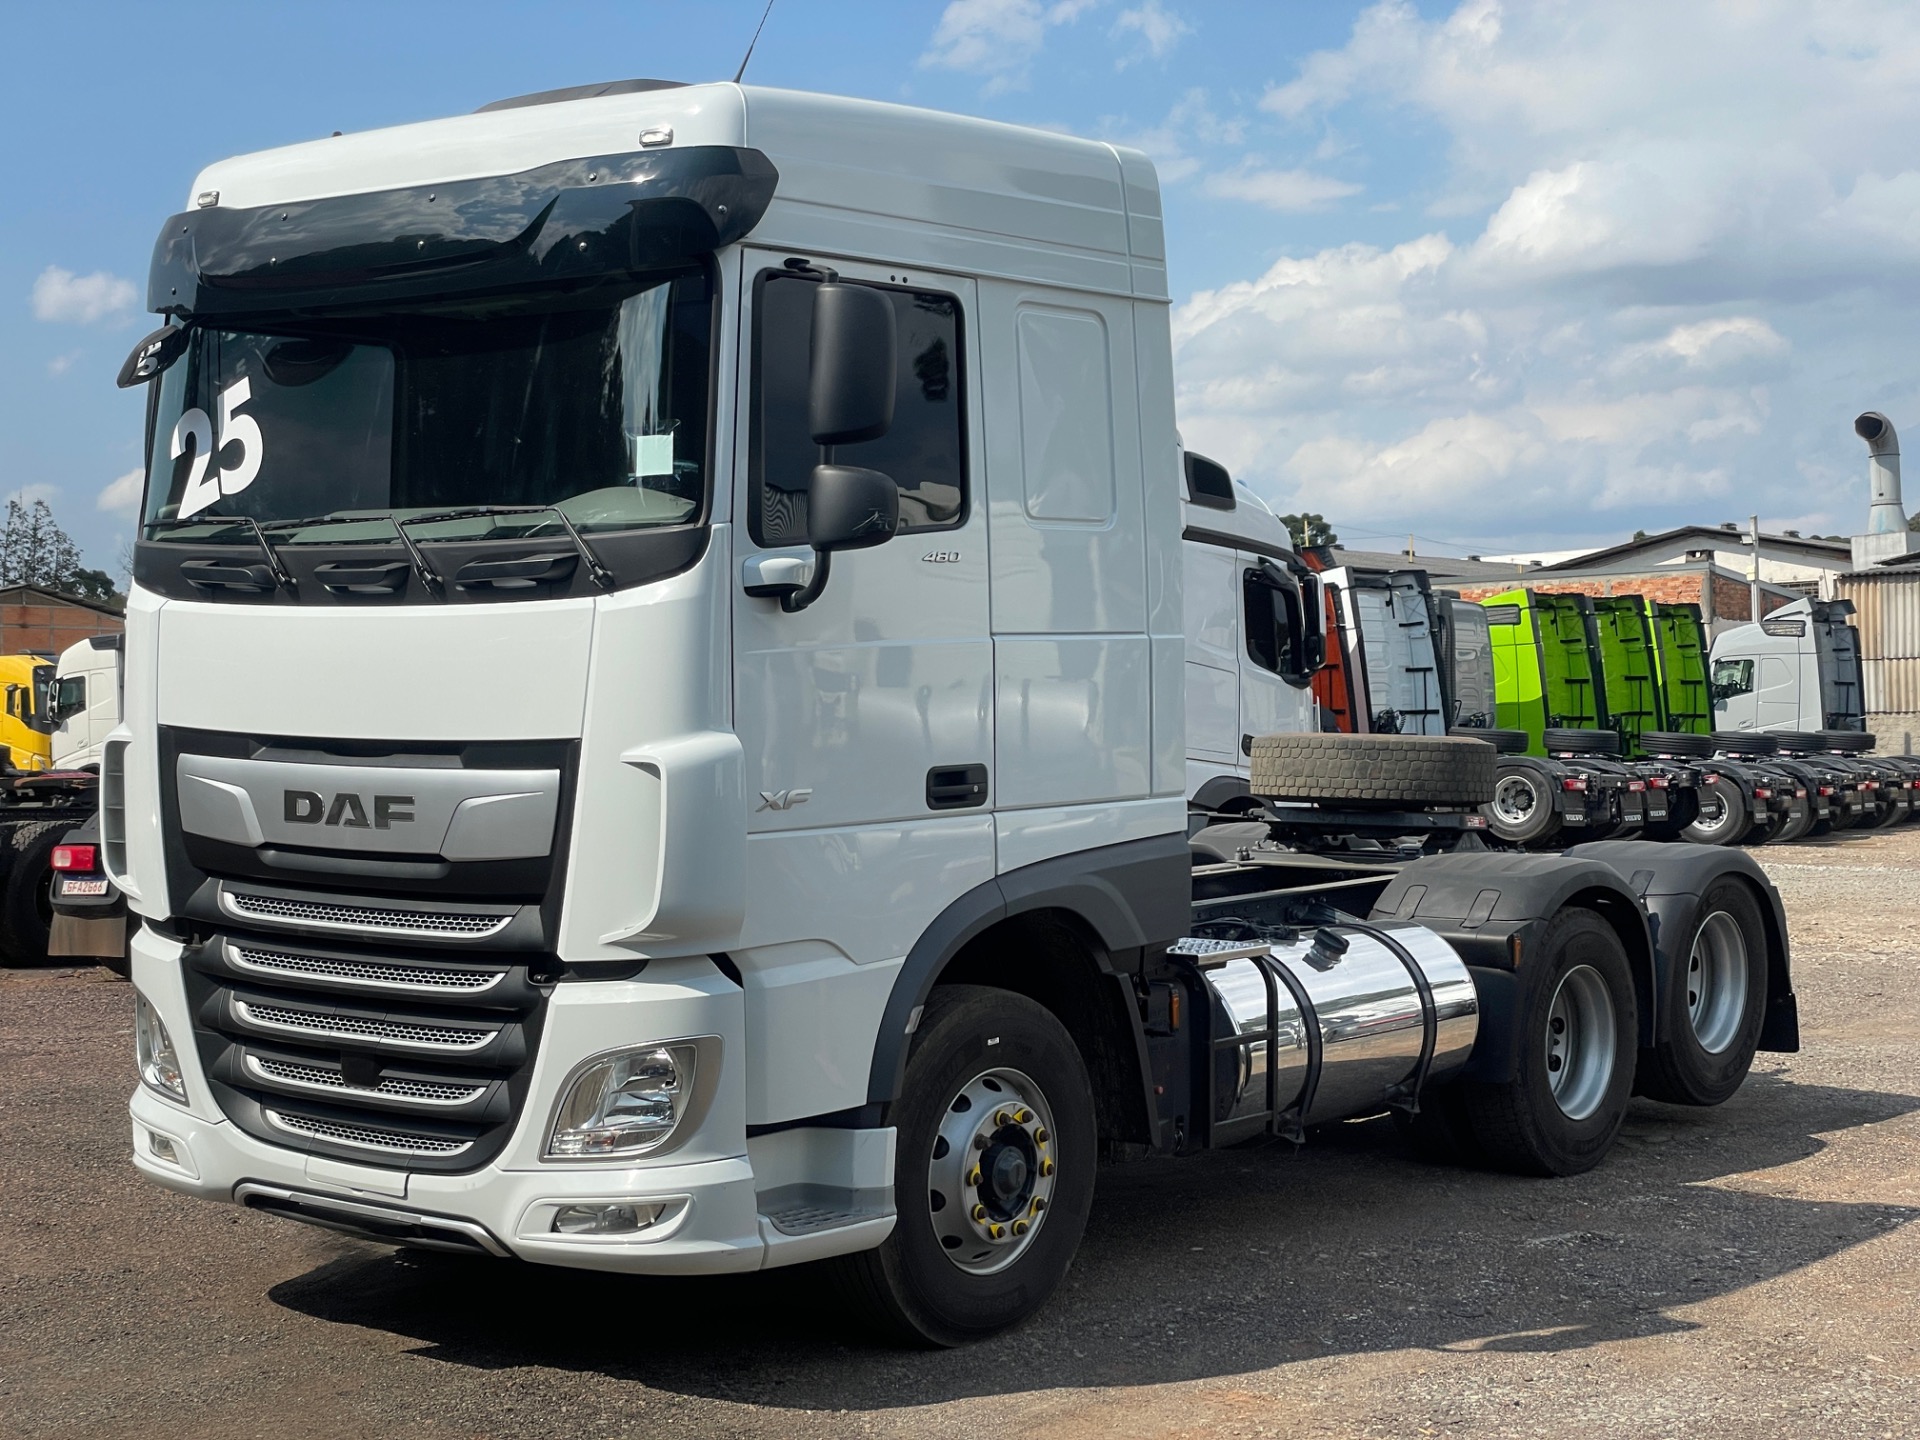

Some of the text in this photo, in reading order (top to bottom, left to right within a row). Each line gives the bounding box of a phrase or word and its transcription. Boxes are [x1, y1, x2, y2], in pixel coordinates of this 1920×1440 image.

[171, 376, 263, 519] 25
[284, 789, 415, 830] DAF
[755, 788, 813, 812] XF
